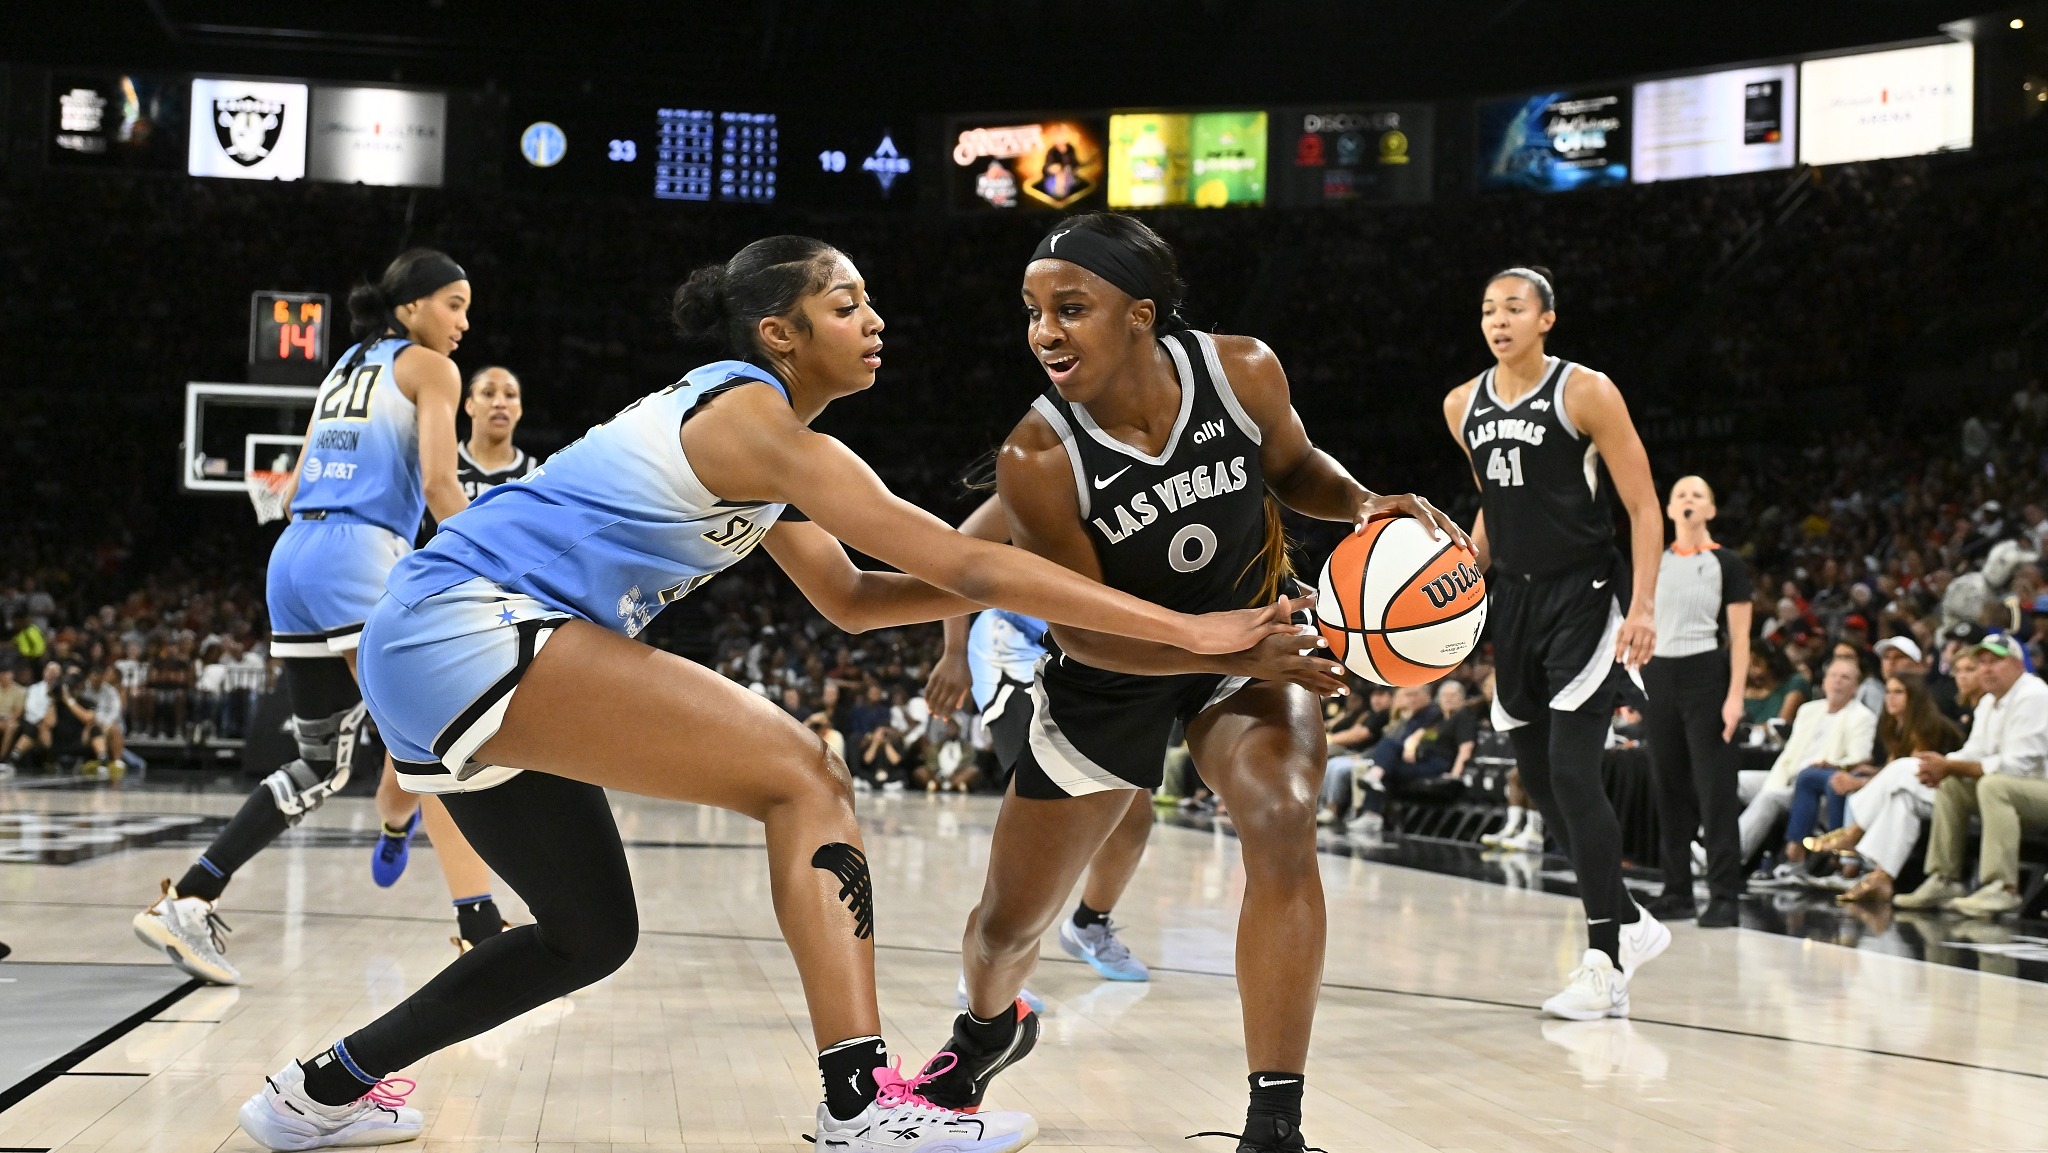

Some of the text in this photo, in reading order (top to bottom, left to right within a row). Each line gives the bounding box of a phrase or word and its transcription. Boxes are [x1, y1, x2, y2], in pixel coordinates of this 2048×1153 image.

[608, 139, 637, 162] 33
[280, 323, 316, 360] 14
[318, 364, 385, 422] 20
[1193, 418, 1225, 444] ally
[1468, 418, 1547, 450] LAS VEGAS
[322, 461, 358, 480] AT&T
[1486, 446, 1525, 487] 41
[1093, 456, 1248, 545] LAS VEGAS
[1168, 523, 1218, 573] 0
